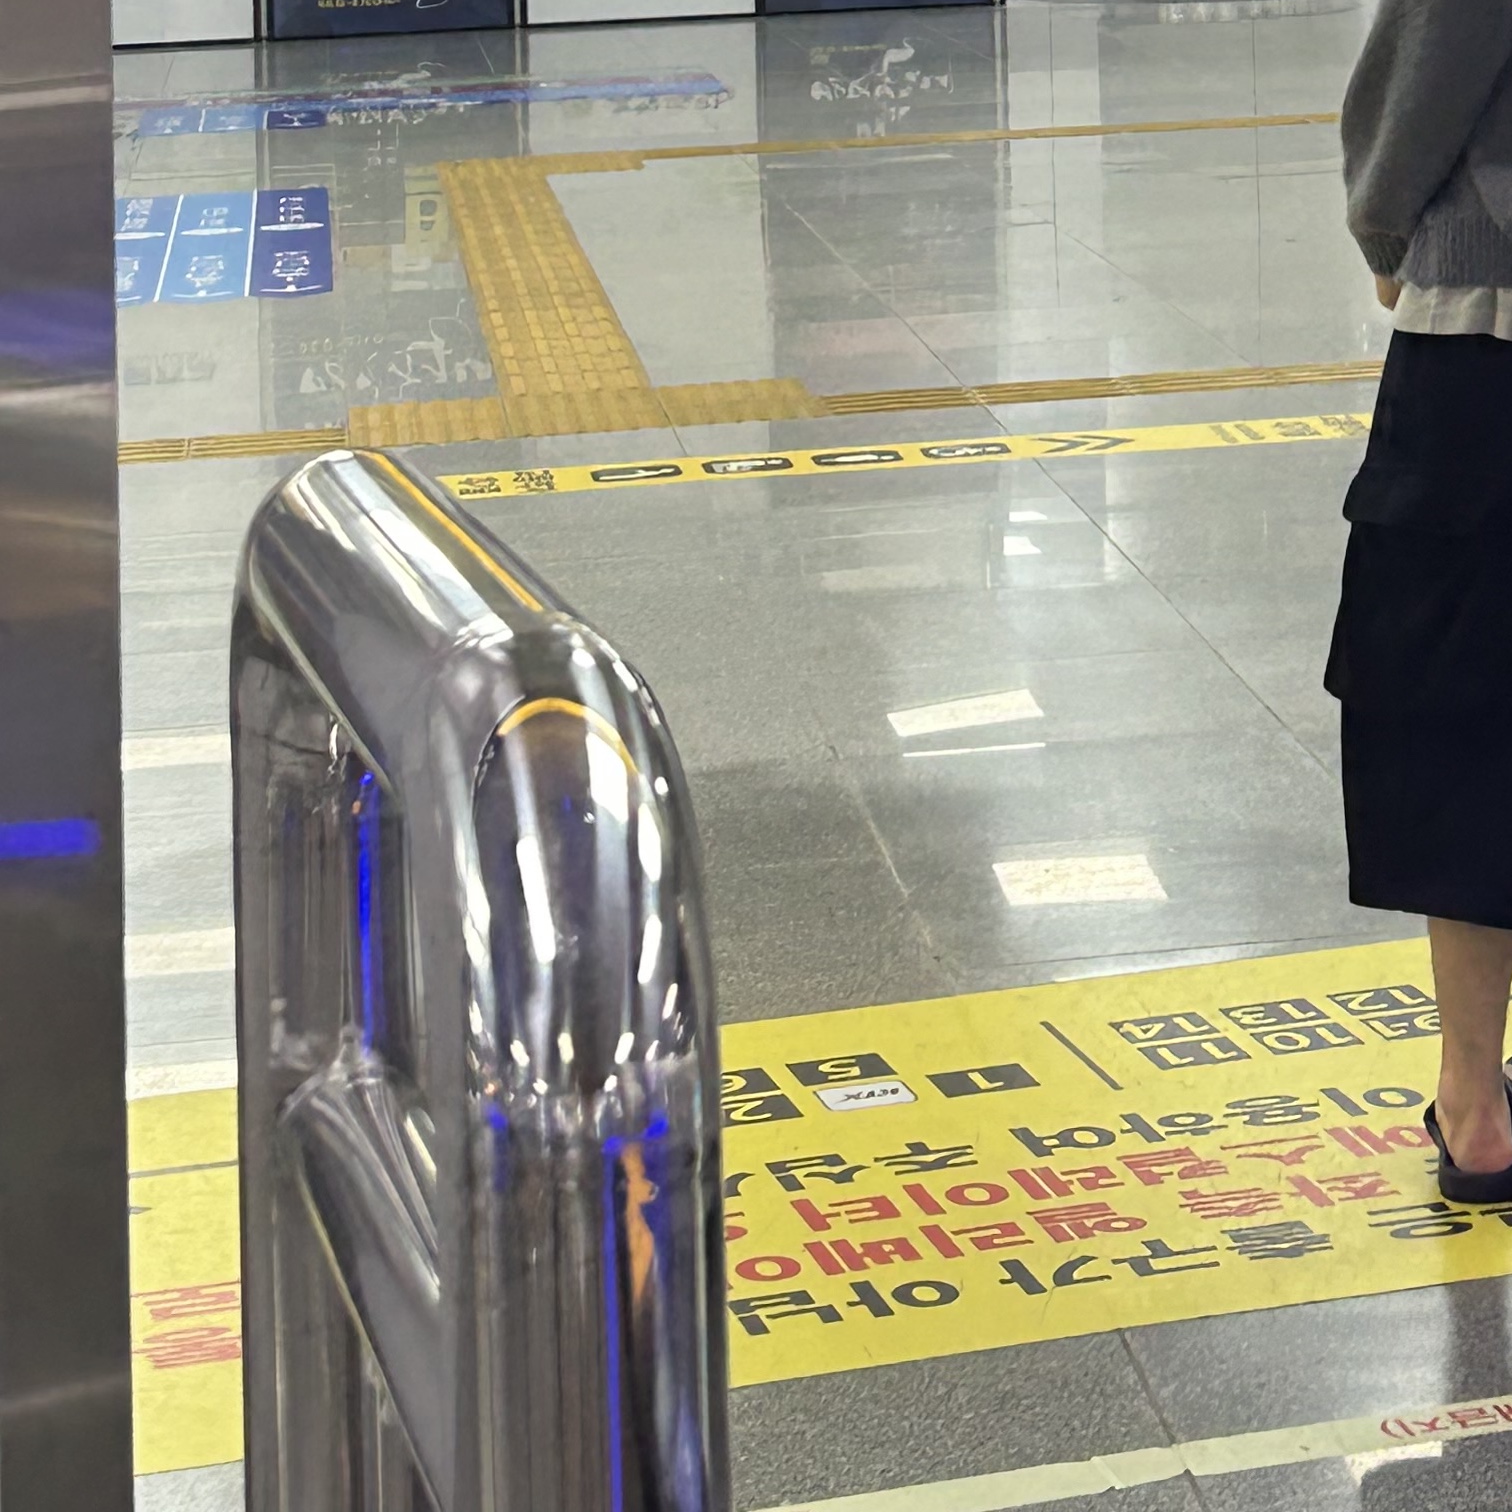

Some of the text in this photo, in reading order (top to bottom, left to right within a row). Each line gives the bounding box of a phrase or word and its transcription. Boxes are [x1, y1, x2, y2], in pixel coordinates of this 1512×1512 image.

[1119, 988, 1427, 1041] 12 13 14
[1262, 1026, 1353, 1051] 10
[1156, 1040, 1239, 1066] 11
[1008, 1087, 1426, 1158] 이용하여
[789, 1125, 1435, 1232] 에스컬레이터
[1179, 1171, 1402, 1219] 좌측
[1000, 1220, 1335, 1296] 출구가
